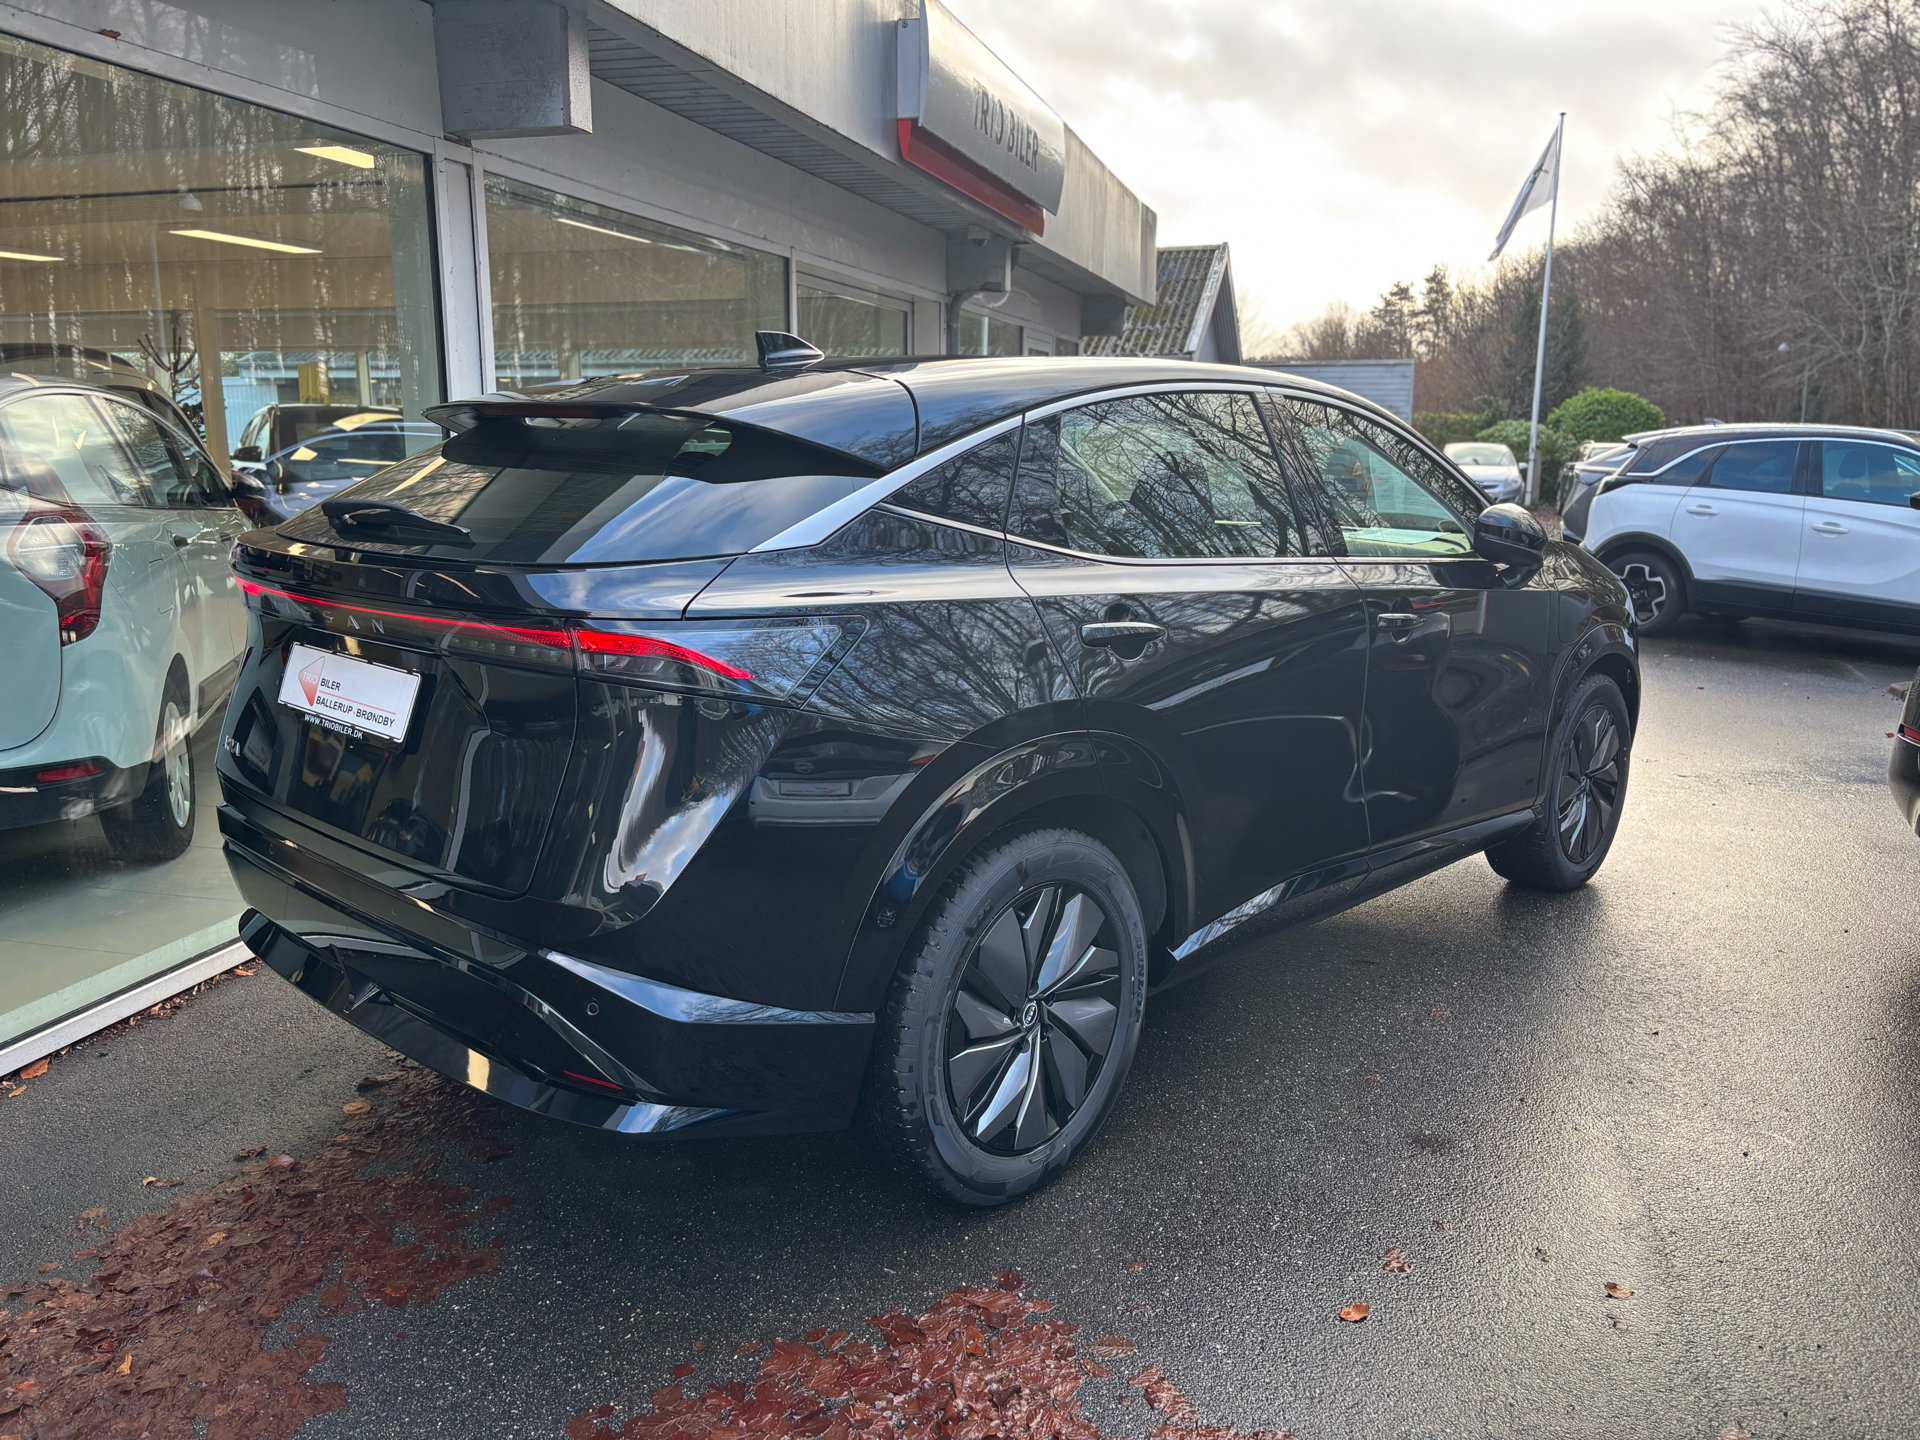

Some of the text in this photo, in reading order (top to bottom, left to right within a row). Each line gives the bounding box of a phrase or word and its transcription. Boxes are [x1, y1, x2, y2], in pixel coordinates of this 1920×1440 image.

[973, 77, 1039, 173] TRIO BILER
[302, 671, 318, 685] TRIO
[320, 677, 341, 691] BILER
[304, 713, 364, 740] WWW.TRIOBILER.DK
